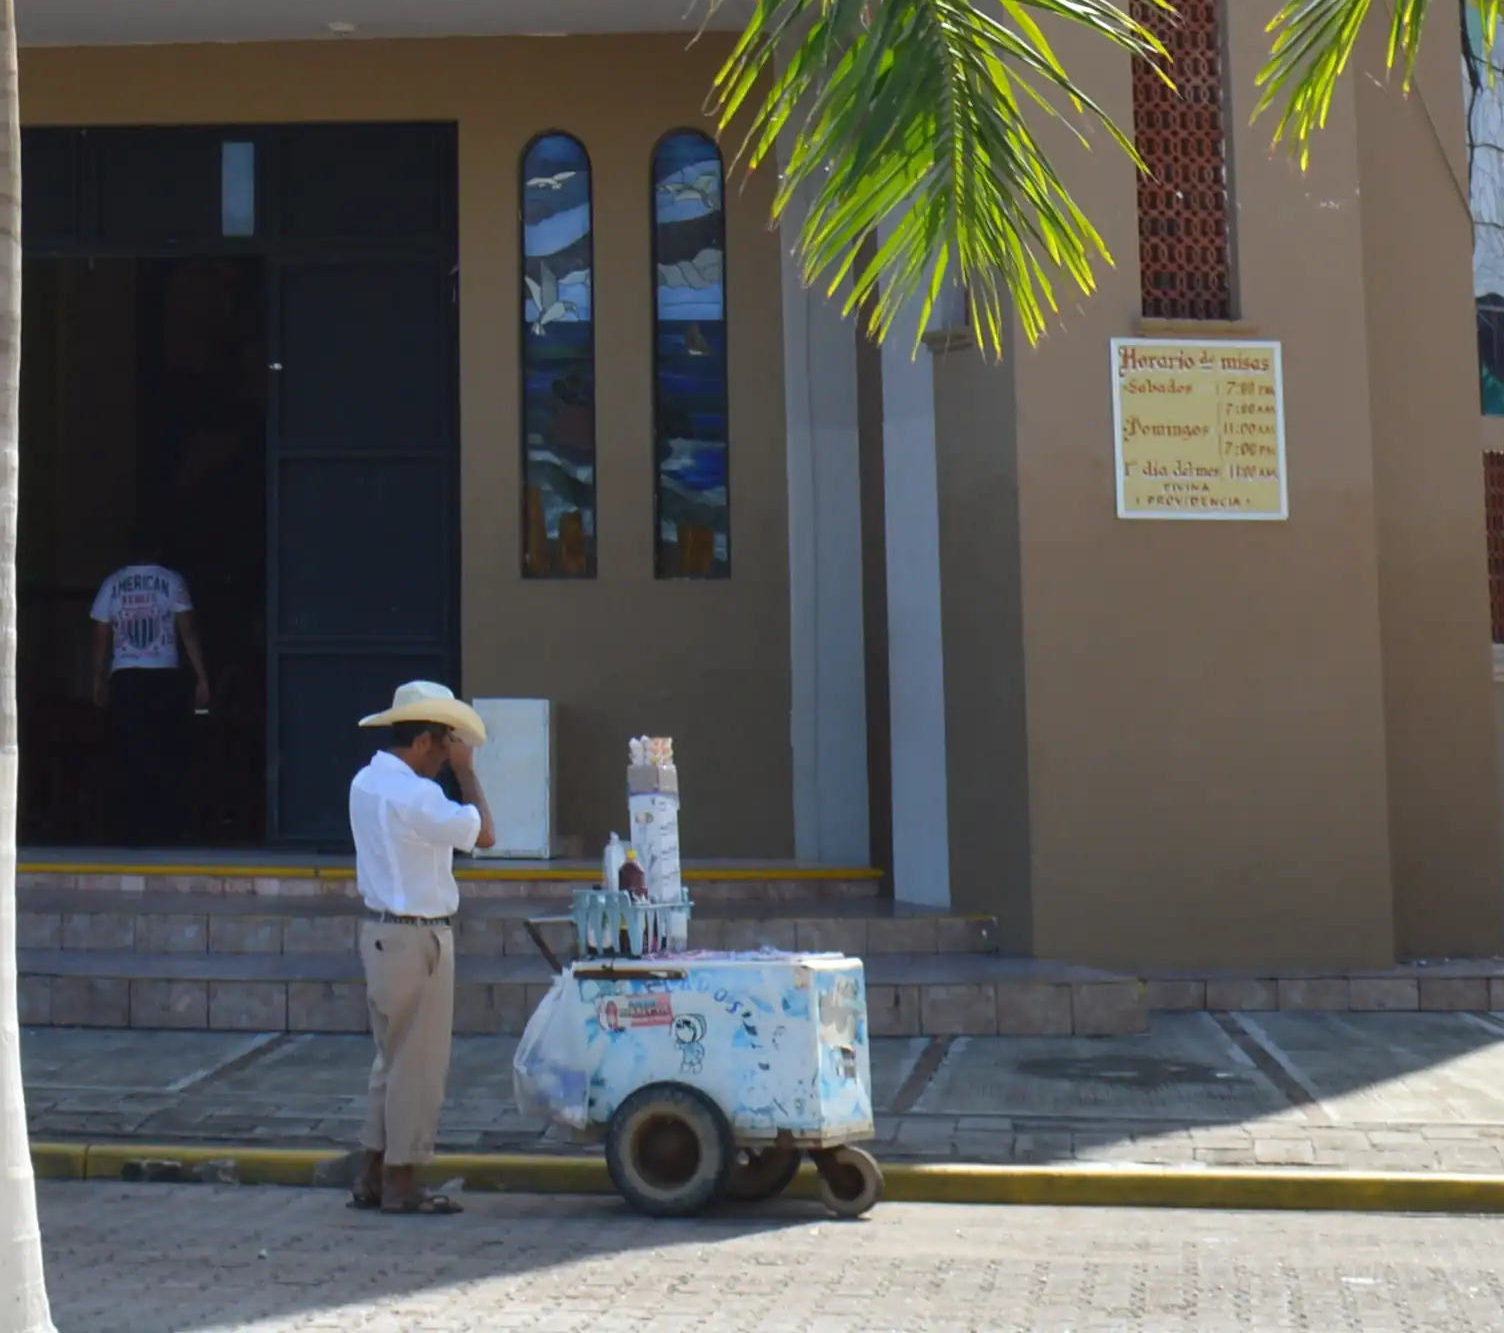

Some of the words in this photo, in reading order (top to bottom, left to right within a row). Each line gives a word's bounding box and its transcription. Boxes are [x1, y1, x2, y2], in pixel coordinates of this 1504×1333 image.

[1119, 346, 1196, 377] Horario
[1221, 353, 1270, 371] misas
[1124, 416, 1210, 441] Domingos
[1147, 495, 1242, 507] PROVIDENCIA
[110, 574, 170, 599] AMERICAN
